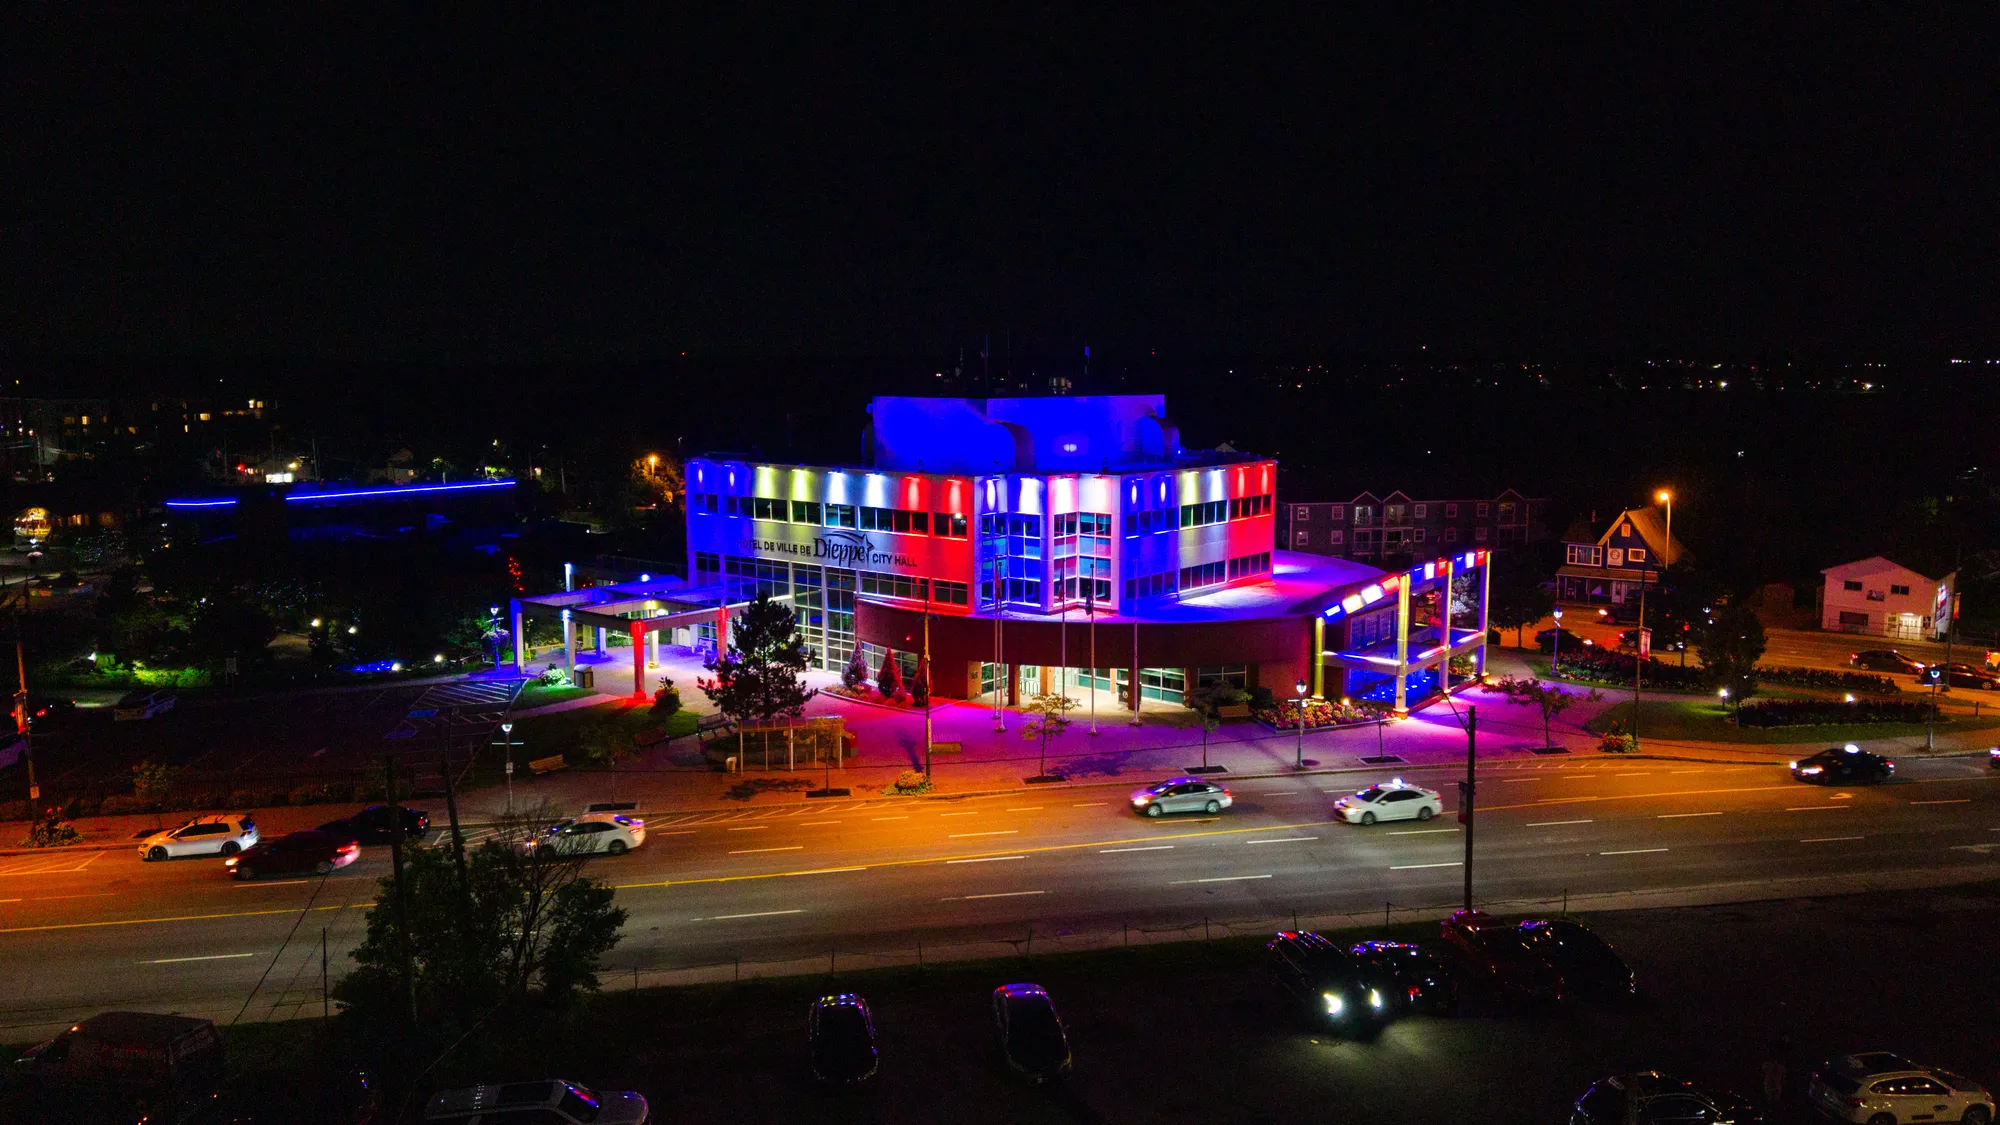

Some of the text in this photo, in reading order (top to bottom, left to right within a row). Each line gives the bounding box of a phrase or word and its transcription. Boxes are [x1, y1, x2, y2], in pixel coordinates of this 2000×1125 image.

[764, 541, 775, 551] DE
[777, 542, 798, 553] VILLE
[800, 545, 811, 556] DE
[813, 537, 866, 567] Dieppe
[872, 553, 892, 565] CITY
[894, 555, 918, 567] HALL
